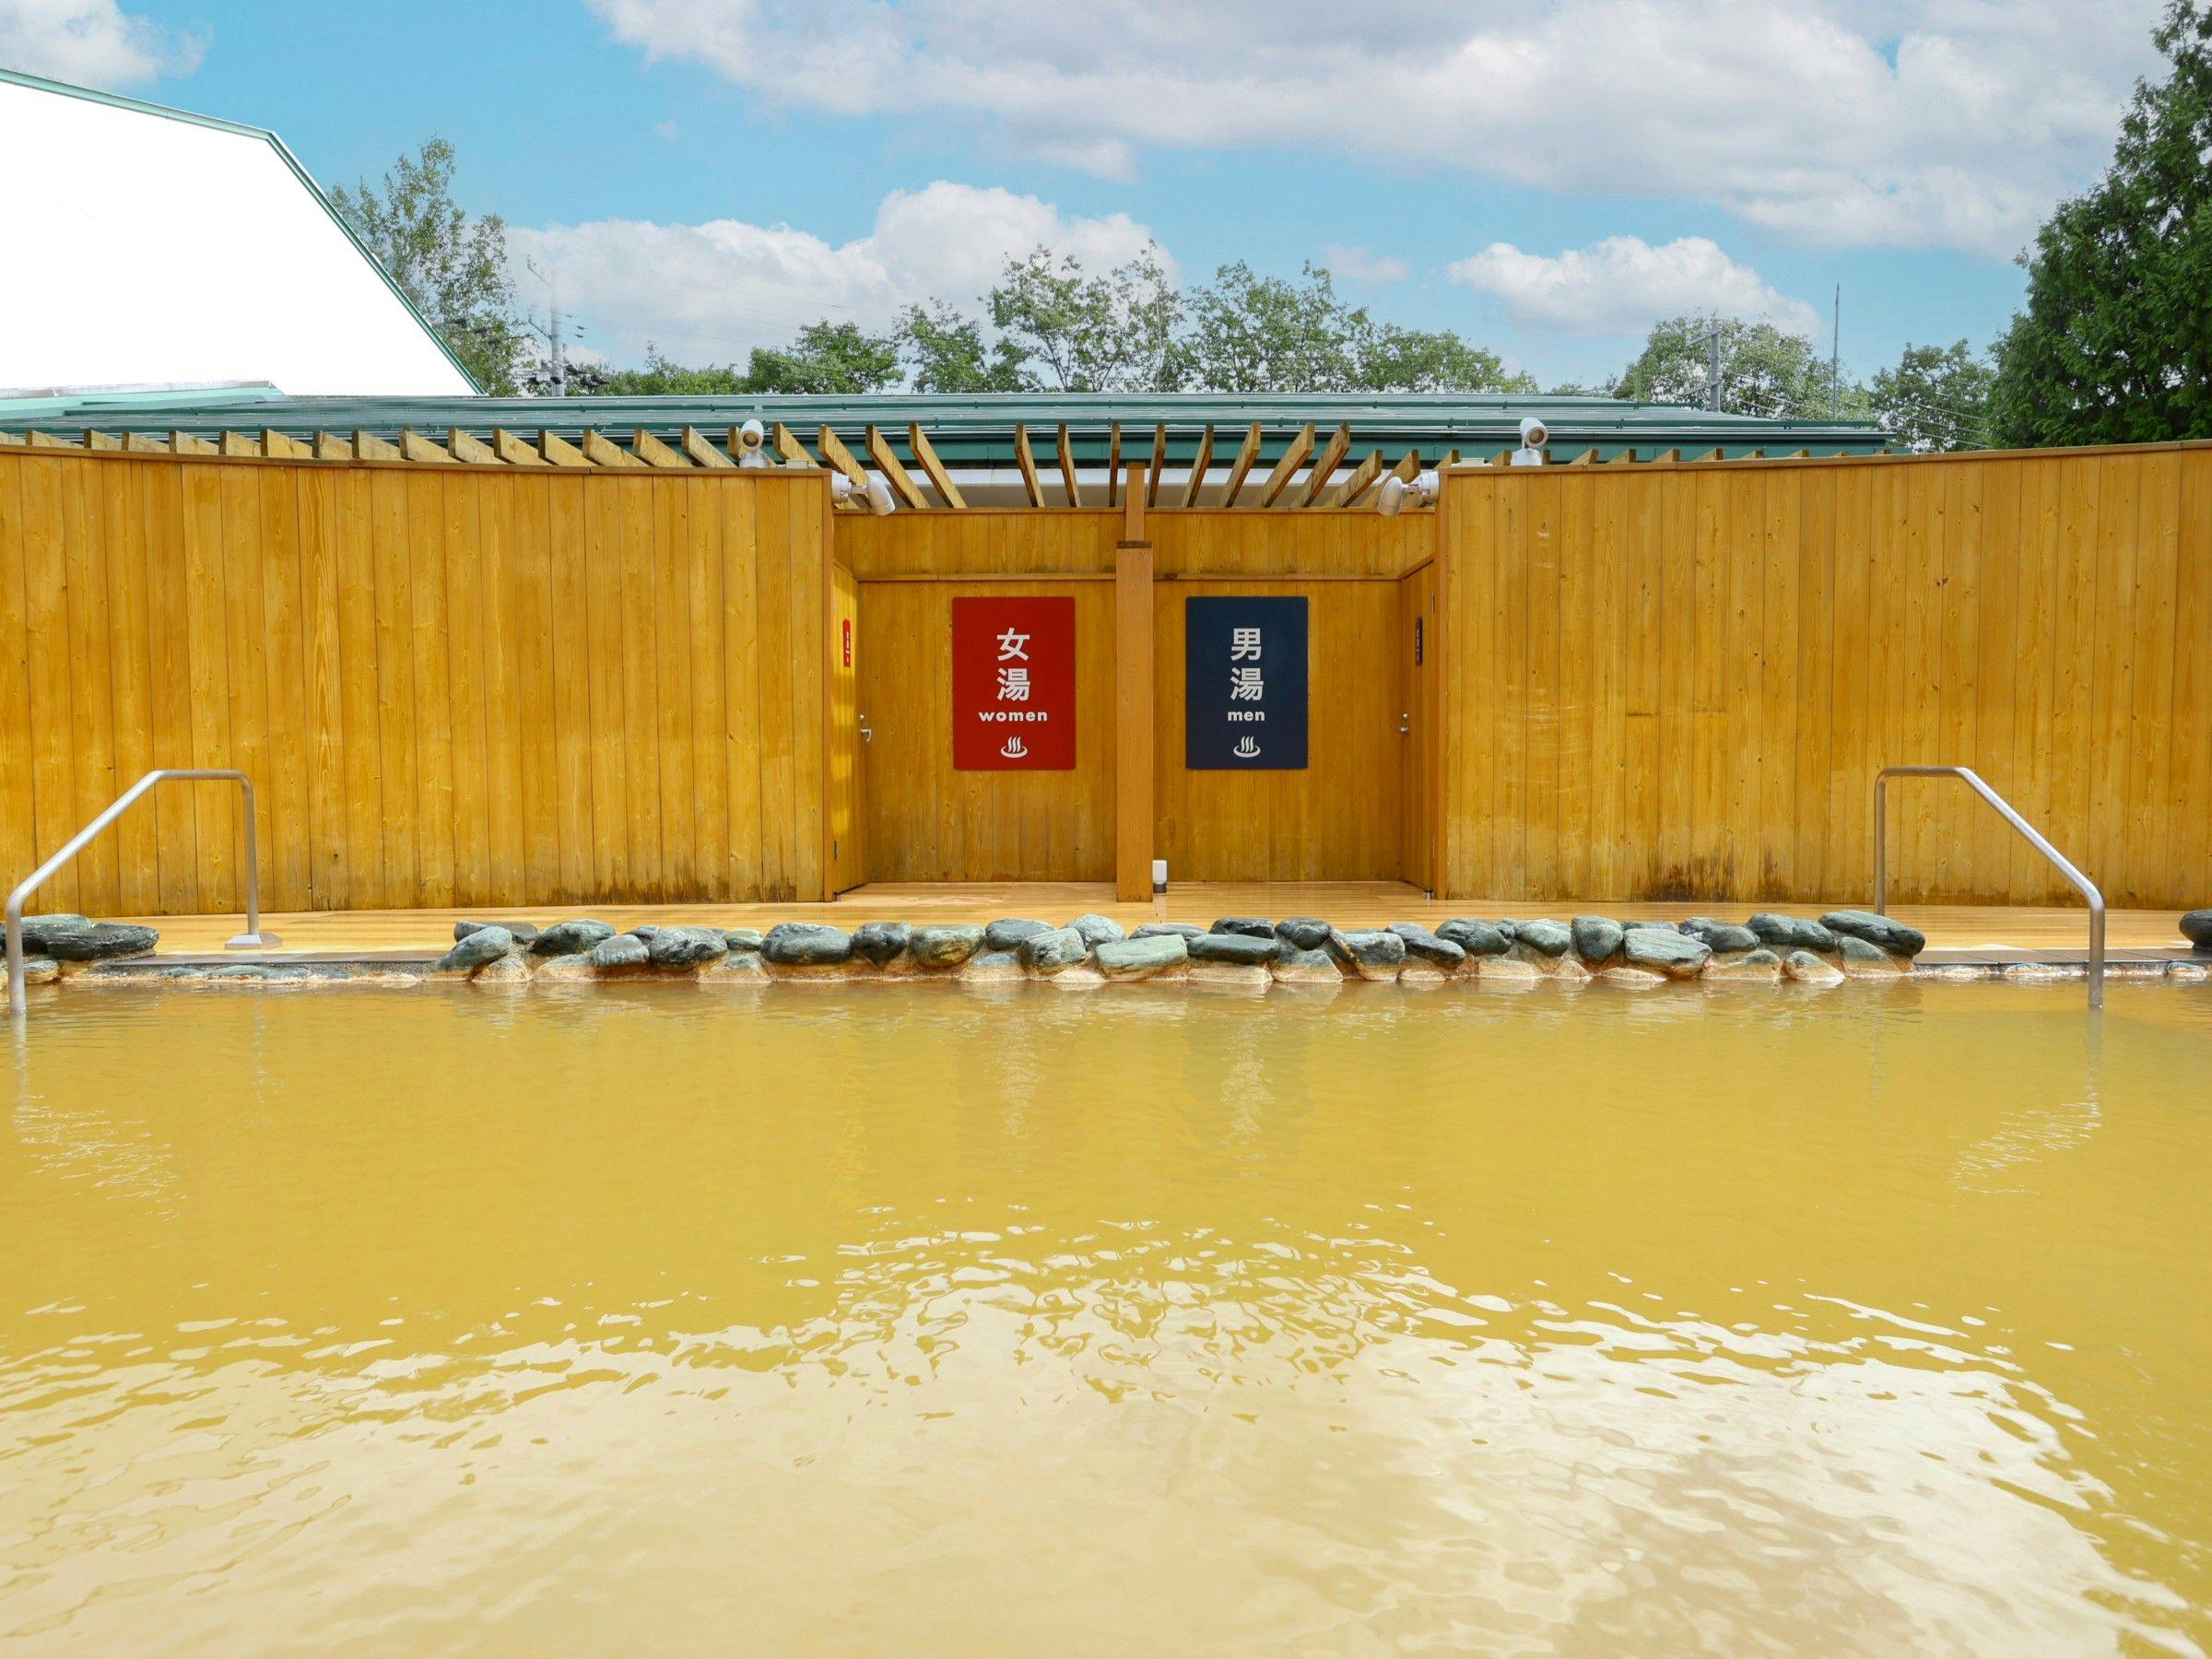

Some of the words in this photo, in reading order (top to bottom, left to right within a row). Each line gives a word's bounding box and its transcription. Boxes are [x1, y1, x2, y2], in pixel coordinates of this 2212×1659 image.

[996, 627, 1030, 701] 女湯
[1230, 628, 1265, 701] 男湯
[978, 711, 1048, 722] women
[1227, 711, 1265, 722] men
